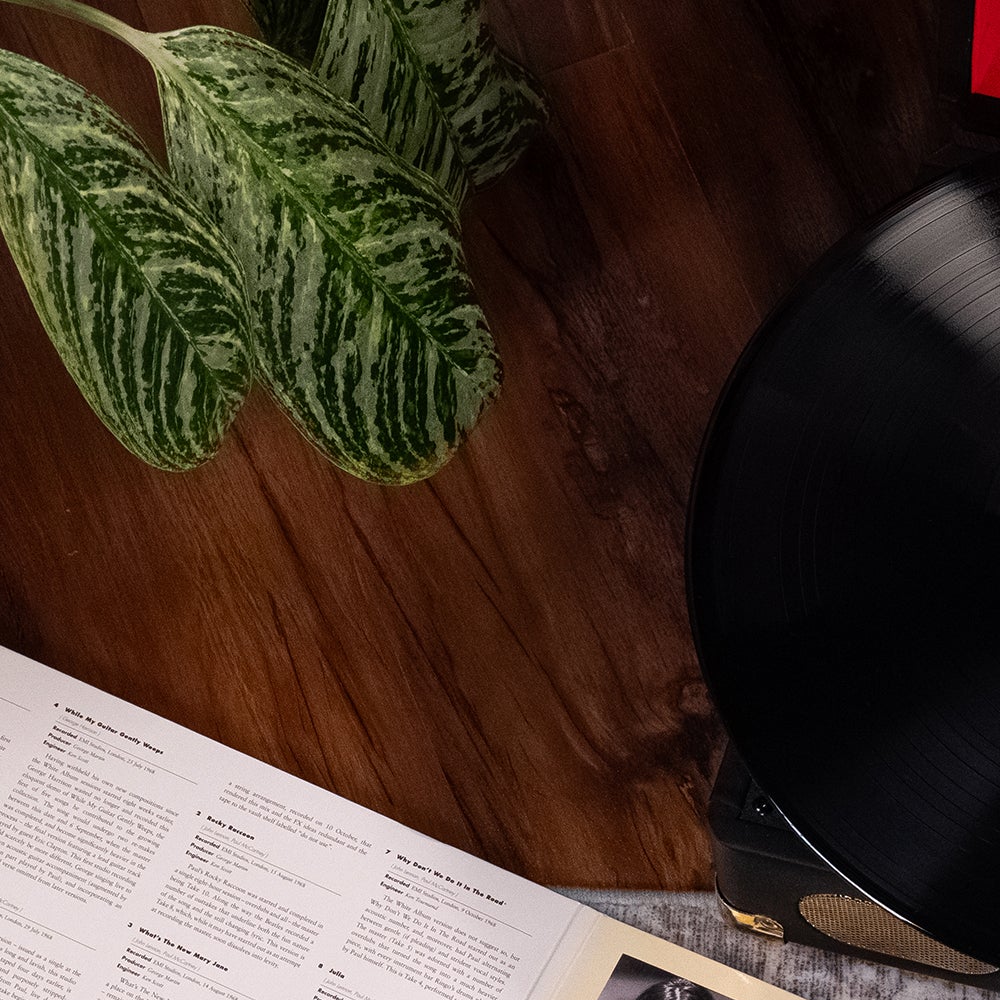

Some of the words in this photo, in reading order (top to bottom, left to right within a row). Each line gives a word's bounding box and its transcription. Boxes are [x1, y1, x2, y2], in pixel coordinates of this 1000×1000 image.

[64, 706, 83, 718] While
[84, 716, 95, 725] My
[96, 721, 118, 734] Guitar
[118, 731, 141, 745] Gently
[142, 741, 163, 754] Weeps
[206, 815, 226, 828] Rocky
[227, 824, 254, 840] Raccoon
[396, 853, 411, 865] Why
[412, 861, 432, 873] Don't
[433, 870, 443, 878] We
[444, 875, 455, 883] Do
[472, 887, 484, 897] The
[138, 926, 161, 941] What's
[162, 937, 175, 947] The
[176, 944, 192, 954] New
[192, 952, 211, 964] Mary
[211, 960, 228, 971] Jane
[328, 967, 345, 979] Julia
